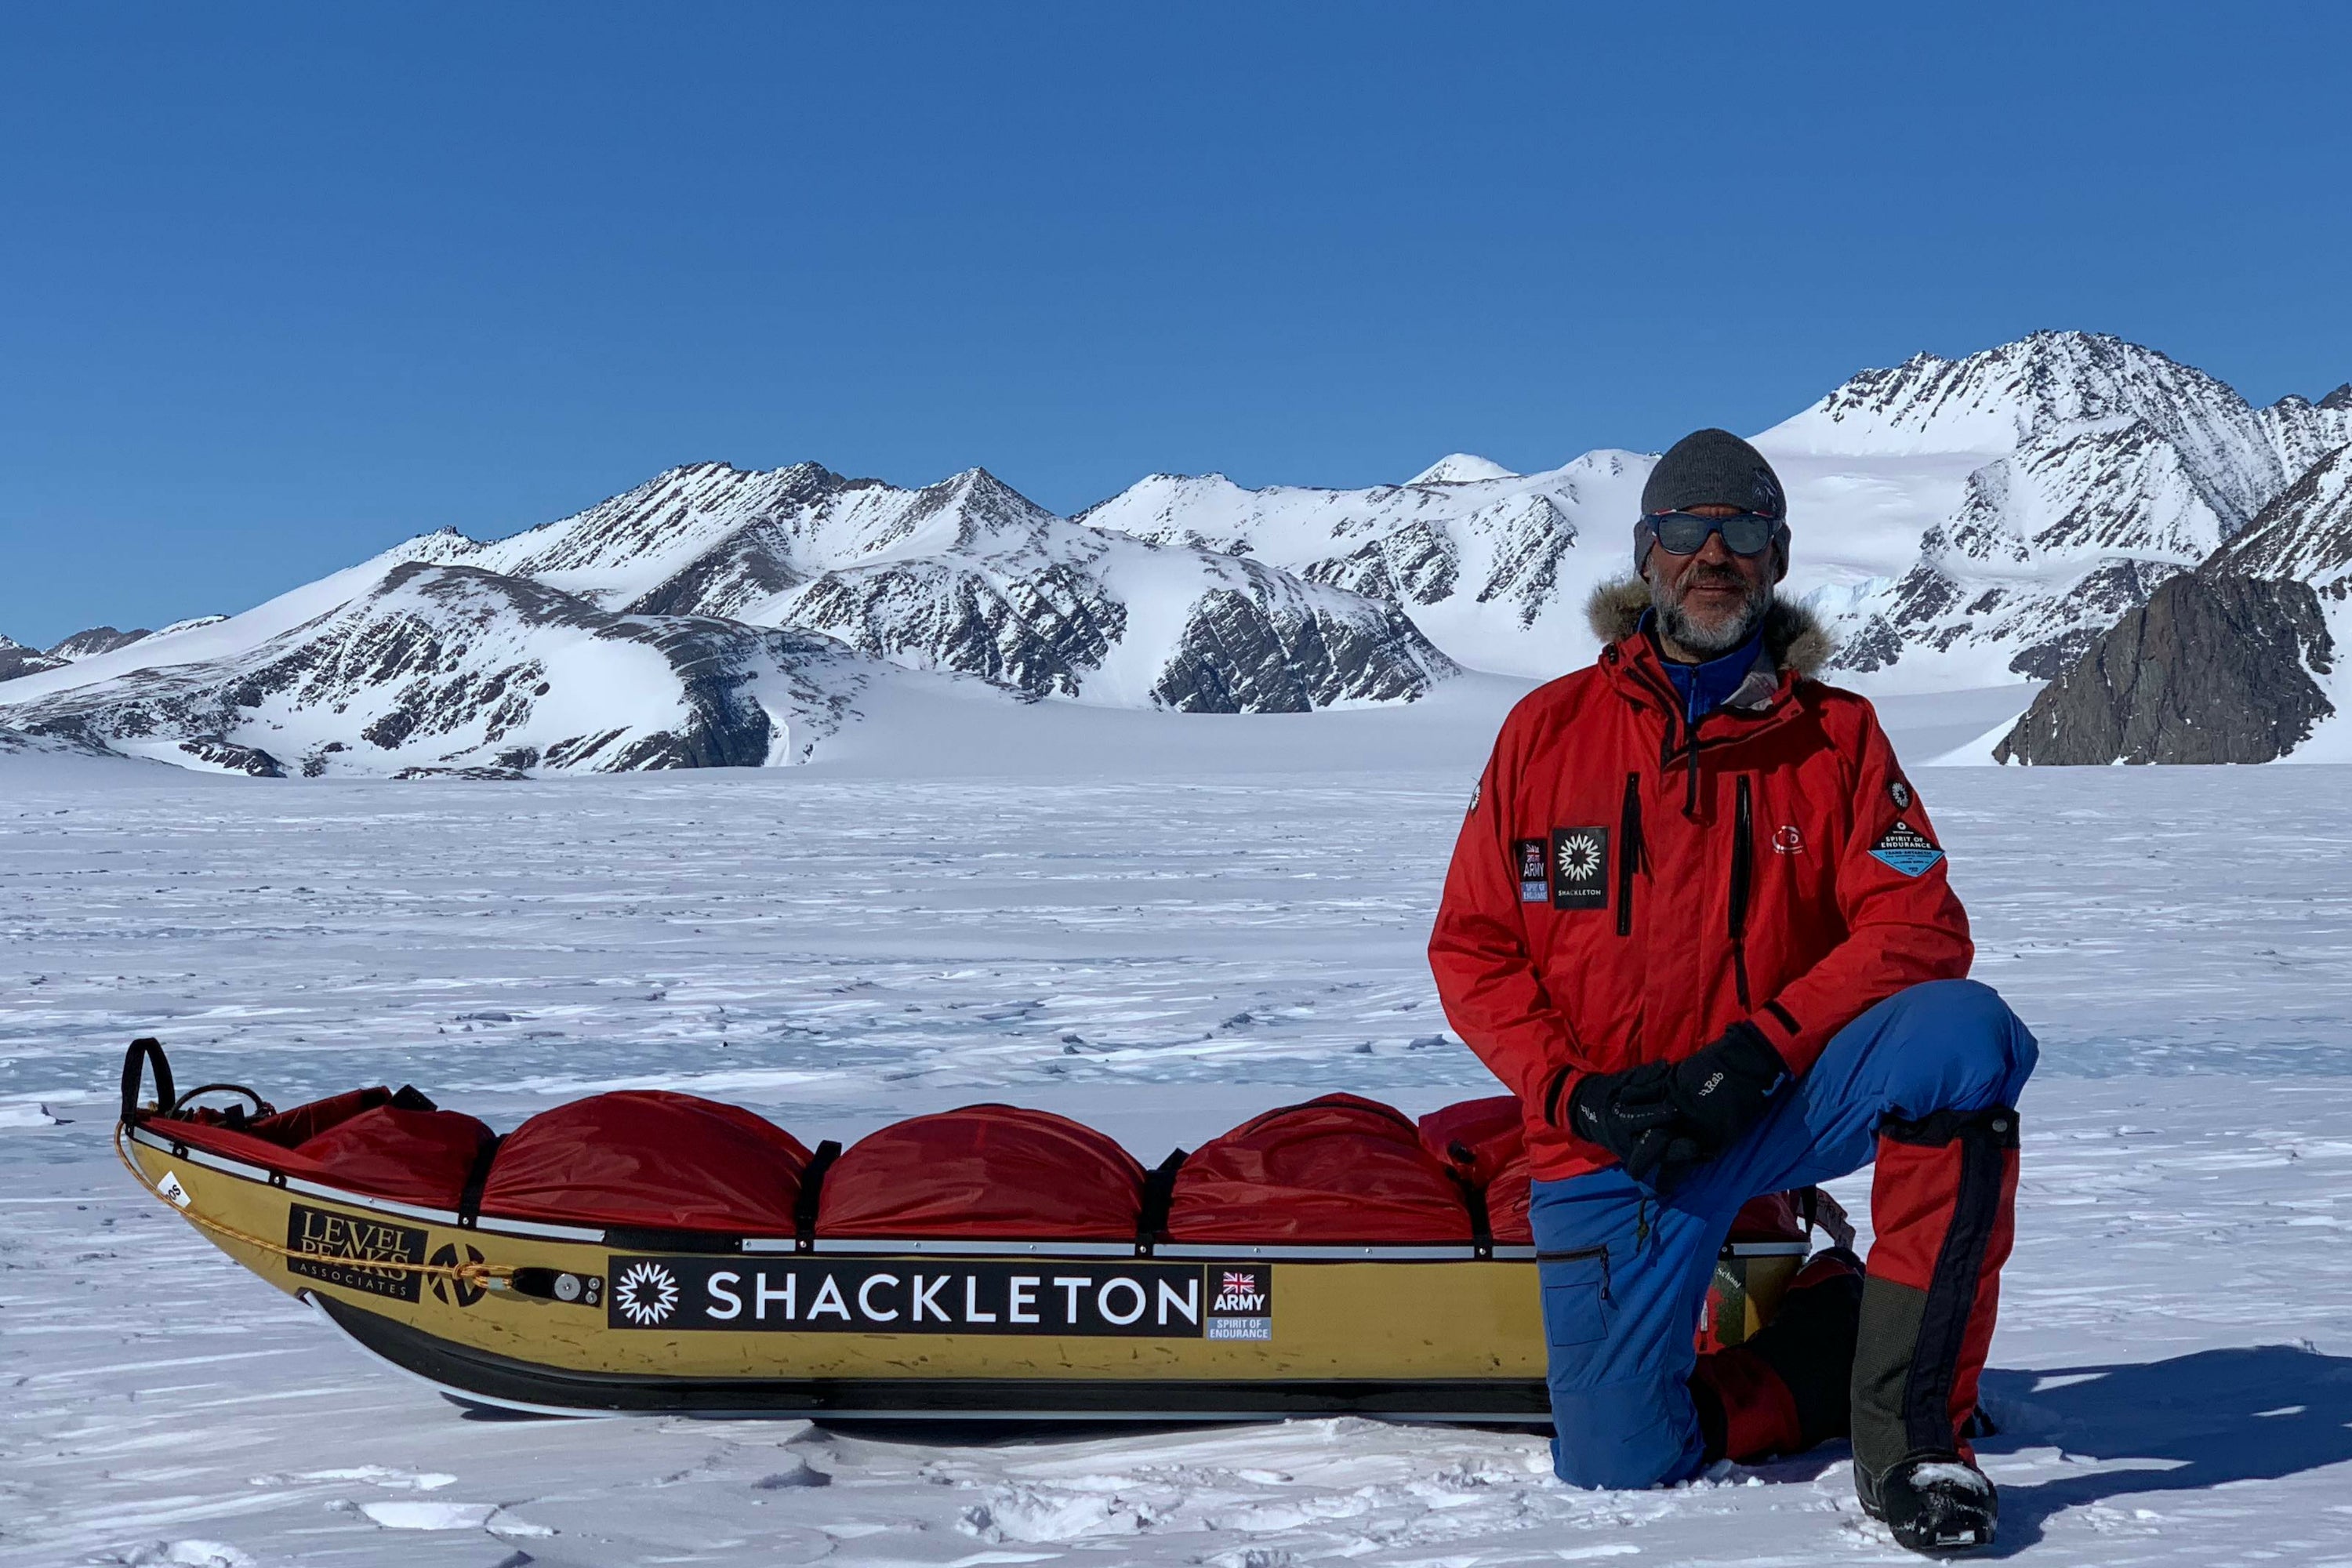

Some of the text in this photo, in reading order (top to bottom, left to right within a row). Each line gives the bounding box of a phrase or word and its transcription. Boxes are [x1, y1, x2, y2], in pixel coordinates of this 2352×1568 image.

[1523, 862, 1544, 877] ARMY
[1704, 1073, 1724, 1091] Rab
[302, 1211, 411, 1255] LEVEL
[299, 1263, 407, 1296] ASSOCIATES
[1716, 1267, 1742, 1289] School
[706, 1271, 1199, 1326] SHACKLETON
[1214, 1294, 1265, 1311] ARMY
[1217, 1319, 1261, 1329] SPIRIT OF
[1210, 1329, 1269, 1338] ENDURANCE
